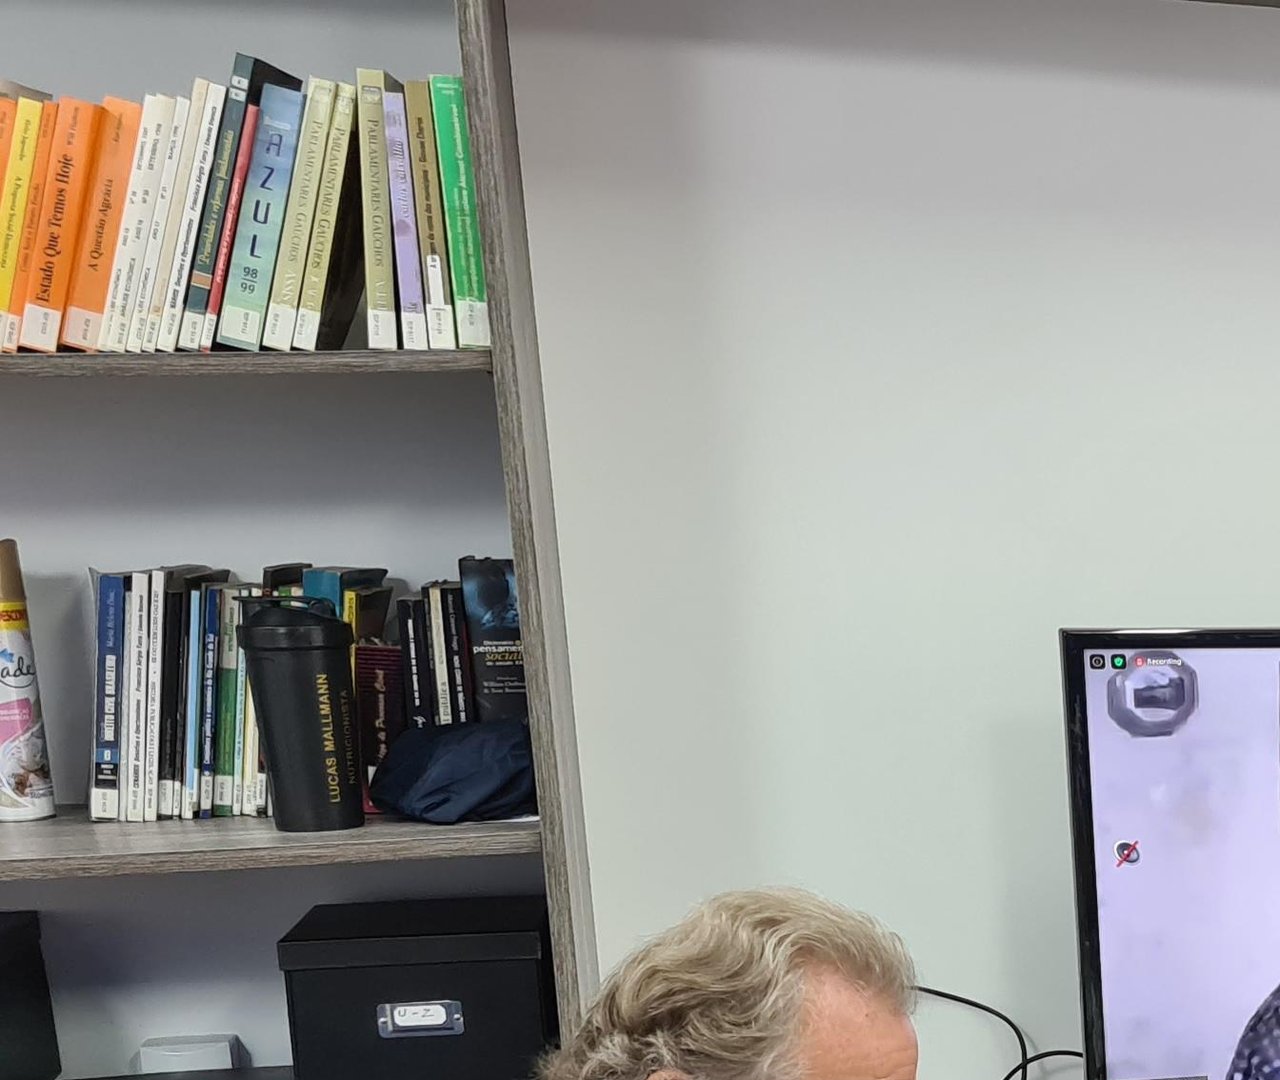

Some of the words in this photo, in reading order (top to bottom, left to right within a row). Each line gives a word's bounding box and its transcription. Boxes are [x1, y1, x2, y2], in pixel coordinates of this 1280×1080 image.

[55, 154, 74, 185] Hoje
[298, 119, 323, 214] PARLAMENTARES
[318, 127, 346, 216] PARLAMENTARES
[367, 119, 380, 214] PARLAMENTARES
[48, 187, 66, 230] Temos
[43, 231, 61, 258] Que
[90, 218, 106, 258] Questão
[372, 215, 384, 268] GAÚCHOS
[36, 260, 55, 303] Estado
[88, 264, 98, 272] A
[240, 282, 255, 294] 99
[243, 266, 259, 279] 98
[1146, 656, 1182, 666] Recording
[316, 674, 336, 751] MALLMANN
[340, 690, 356, 785] NUTRICIONISTA
[326, 756, 340, 803] LUCAS
